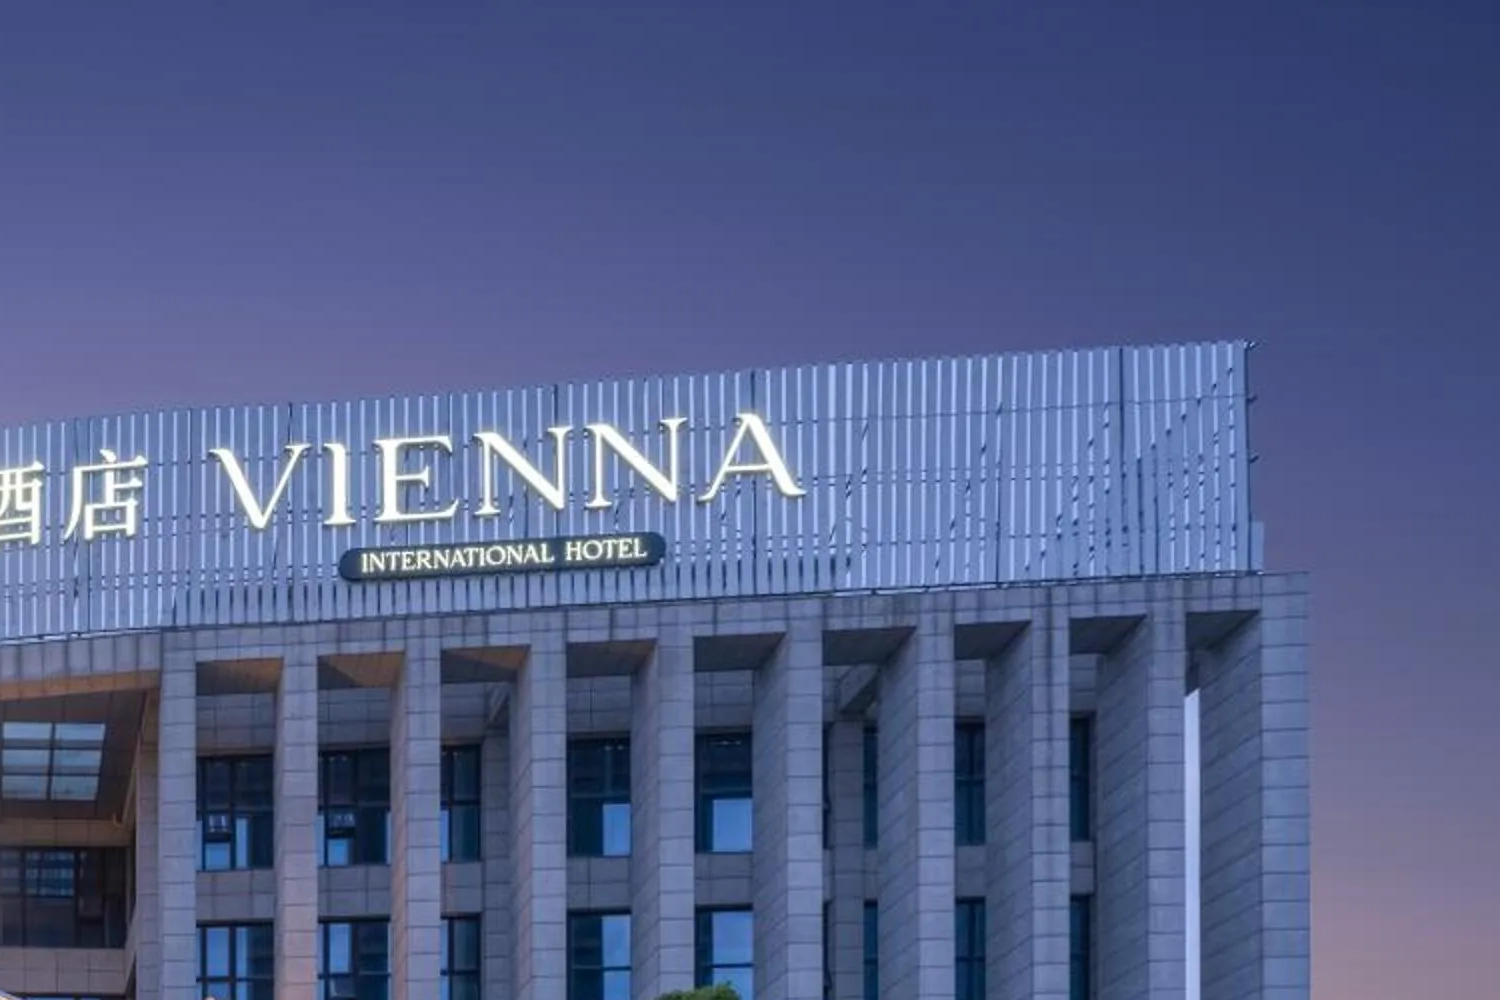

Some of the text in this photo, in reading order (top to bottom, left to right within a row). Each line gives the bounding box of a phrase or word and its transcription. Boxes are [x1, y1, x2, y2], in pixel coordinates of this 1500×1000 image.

[209, 412, 807, 530] VIENNA
[360, 536, 648, 574] INTERNATIONAL HOTEL
